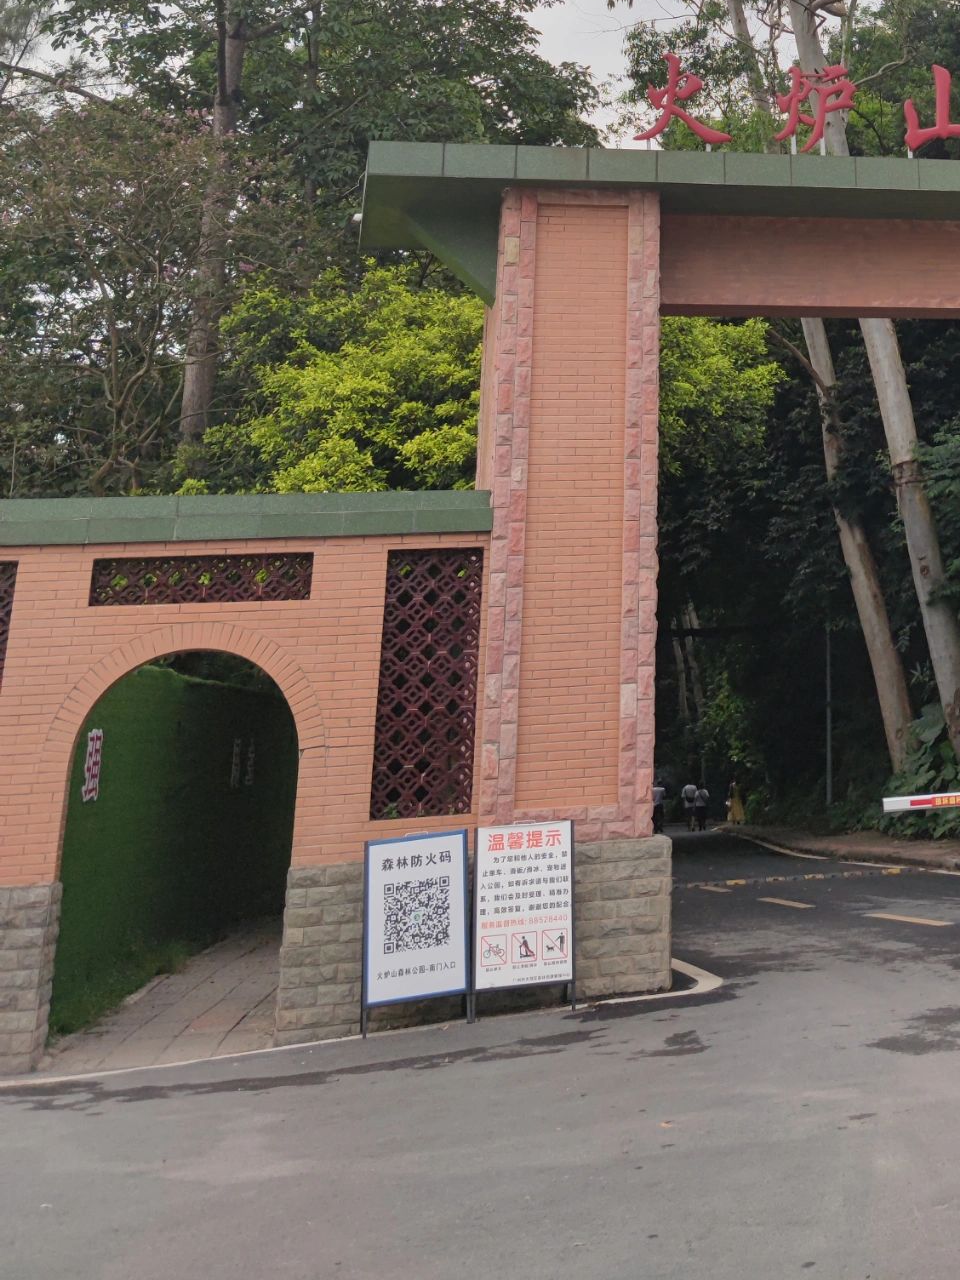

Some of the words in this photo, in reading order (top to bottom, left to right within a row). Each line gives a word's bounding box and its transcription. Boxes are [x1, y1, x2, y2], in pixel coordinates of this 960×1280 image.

[488, 830, 562, 852] 温馨提示
[381, 850, 452, 872] 森林防火码
